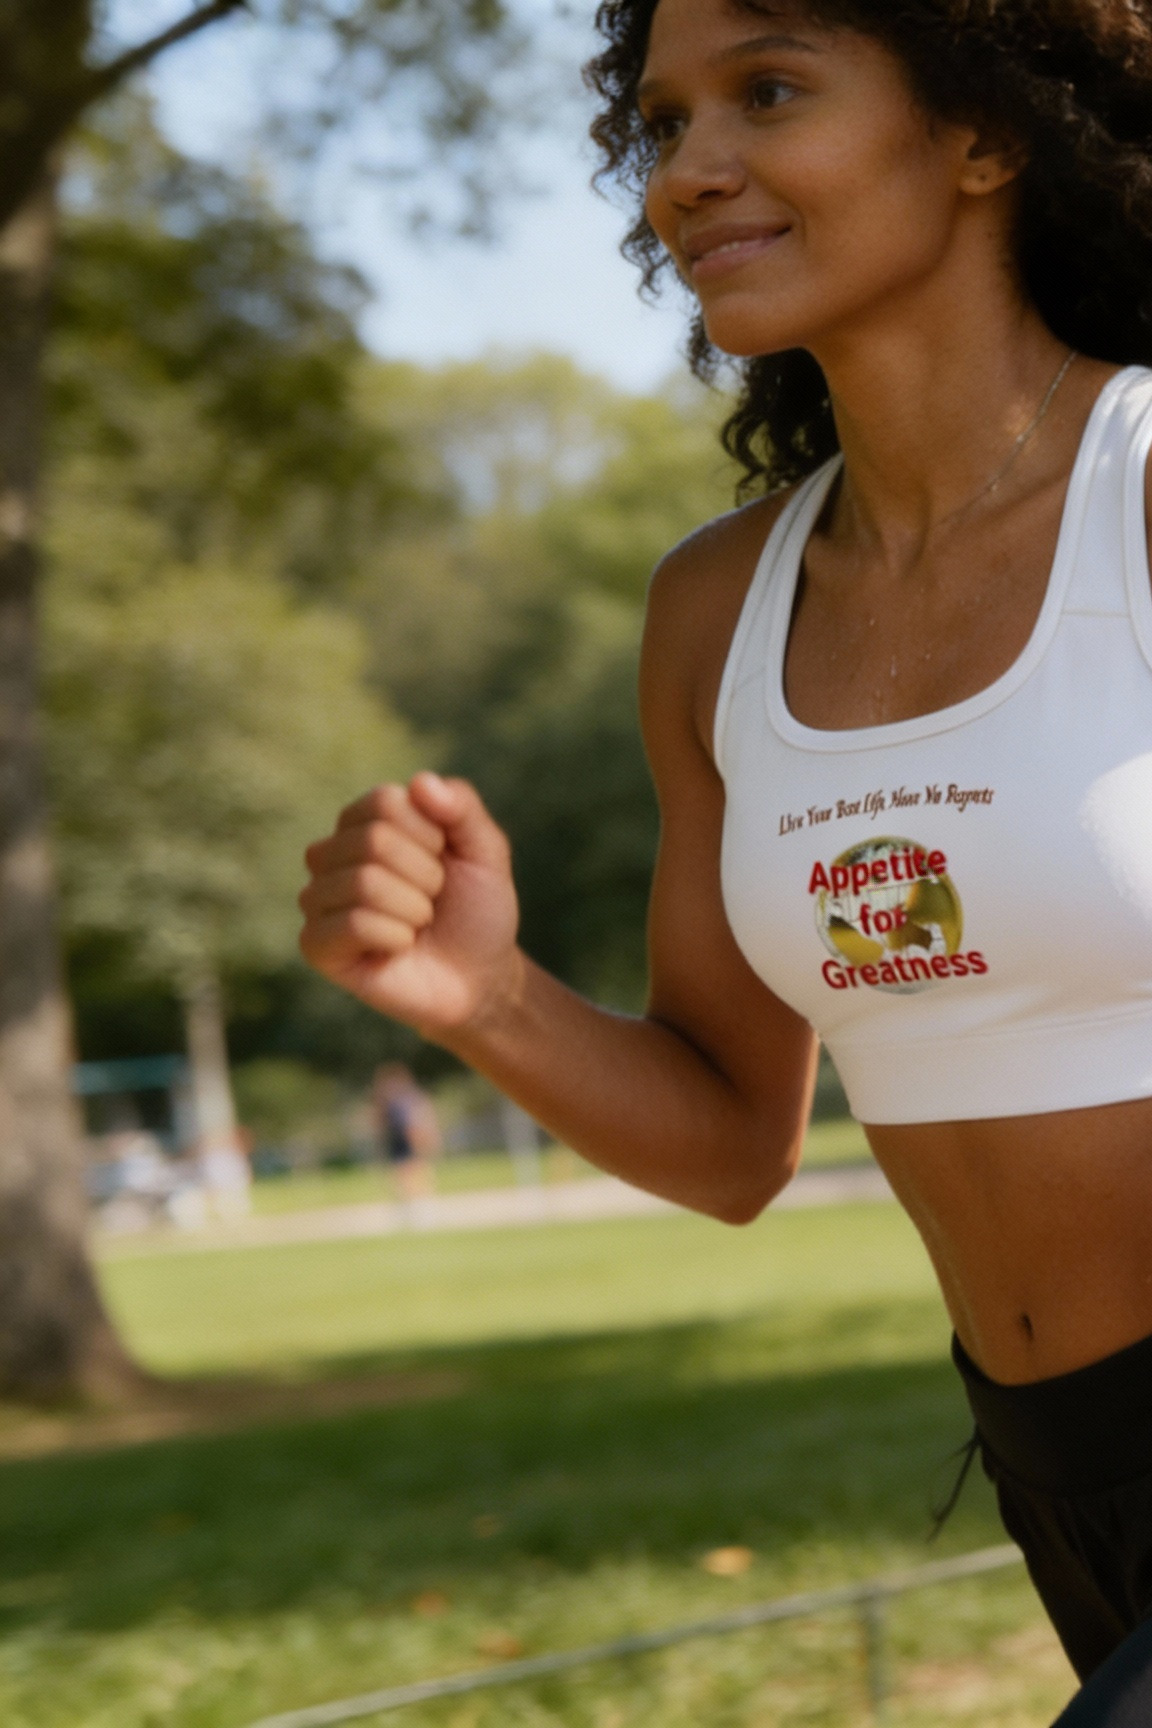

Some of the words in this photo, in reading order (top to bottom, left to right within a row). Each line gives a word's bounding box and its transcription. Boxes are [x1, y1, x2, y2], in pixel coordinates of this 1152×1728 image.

[807, 806, 832, 826] Your
[808, 847, 947, 898] Appetite
[859, 902, 908, 936] for
[821, 951, 988, 990] Greatness
